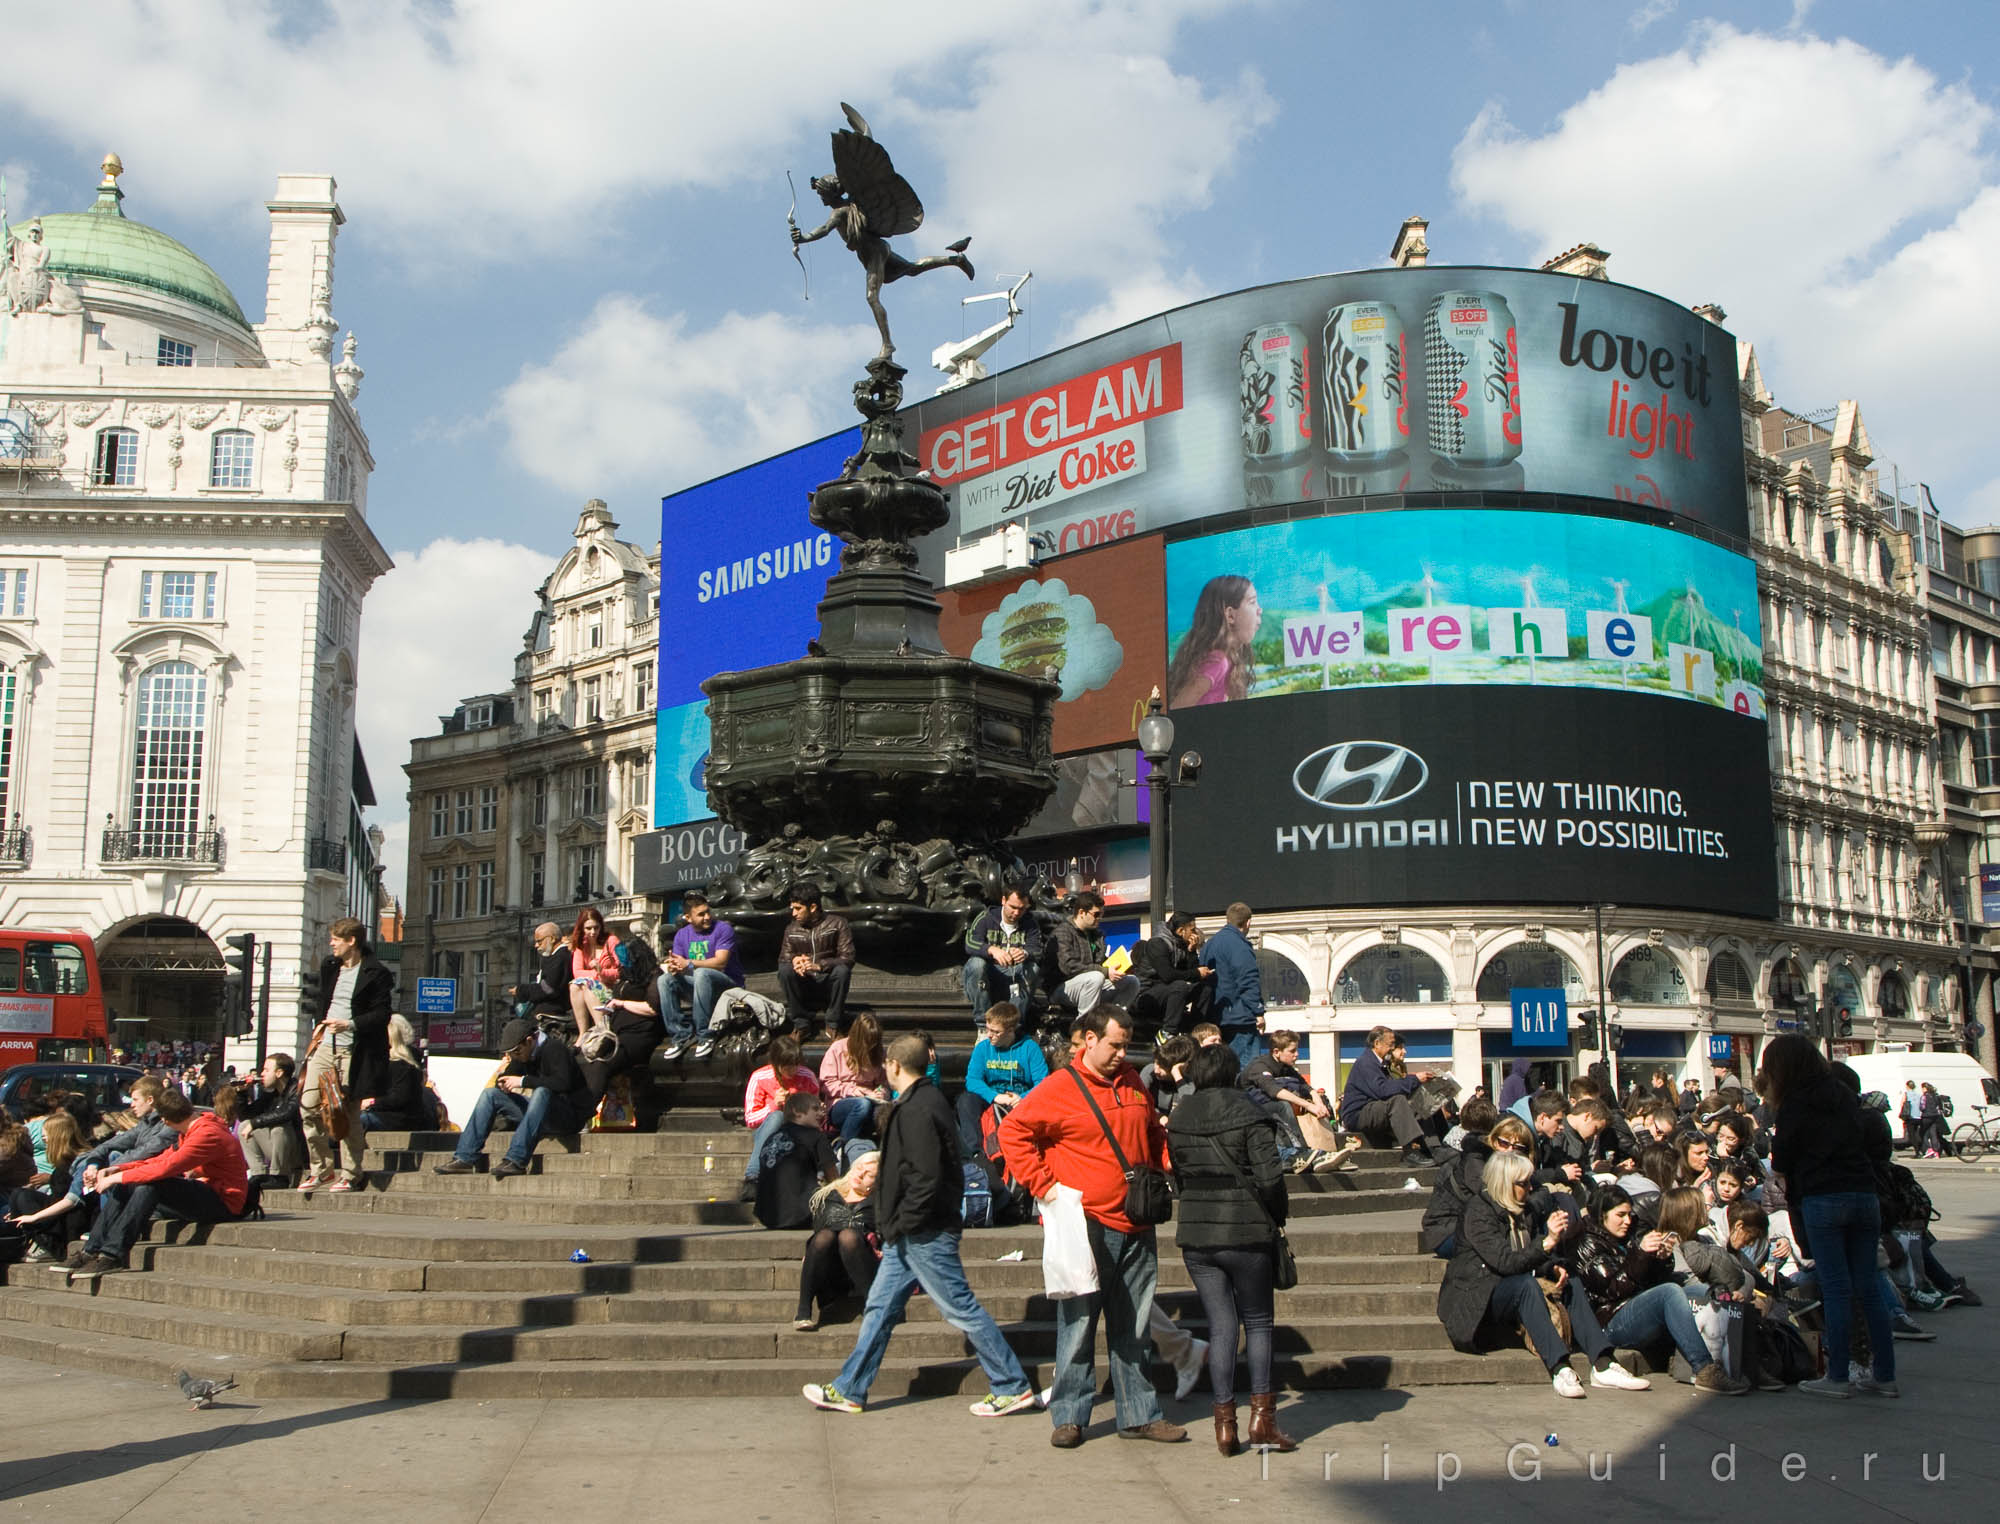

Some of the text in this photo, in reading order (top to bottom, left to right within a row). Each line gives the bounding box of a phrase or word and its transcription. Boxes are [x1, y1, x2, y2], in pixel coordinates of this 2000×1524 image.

[1466, 310, 1486, 320] OFF
[1382, 342, 1401, 405] Diet
[1484, 338, 1509, 409] Diet
[1558, 301, 1712, 409] love it
[931, 357, 1163, 479] GET GLAM
[1608, 380, 1695, 460] light
[966, 439, 1137, 513] WITH Diet Coke
[698, 533, 832, 603] SAMSUNG
[1469, 782, 1687, 818] NEW THINKING.
[1276, 819, 1449, 854] HYUNDAI
[1471, 818, 1728, 859] NEW POSSIBILITIES.
[677, 862, 733, 882] MILANO
[1521, 1002, 1558, 1033] GAP
[0, 1041, 34, 1049] ARRIVA
[1712, 1041, 1727, 1054] GAP
